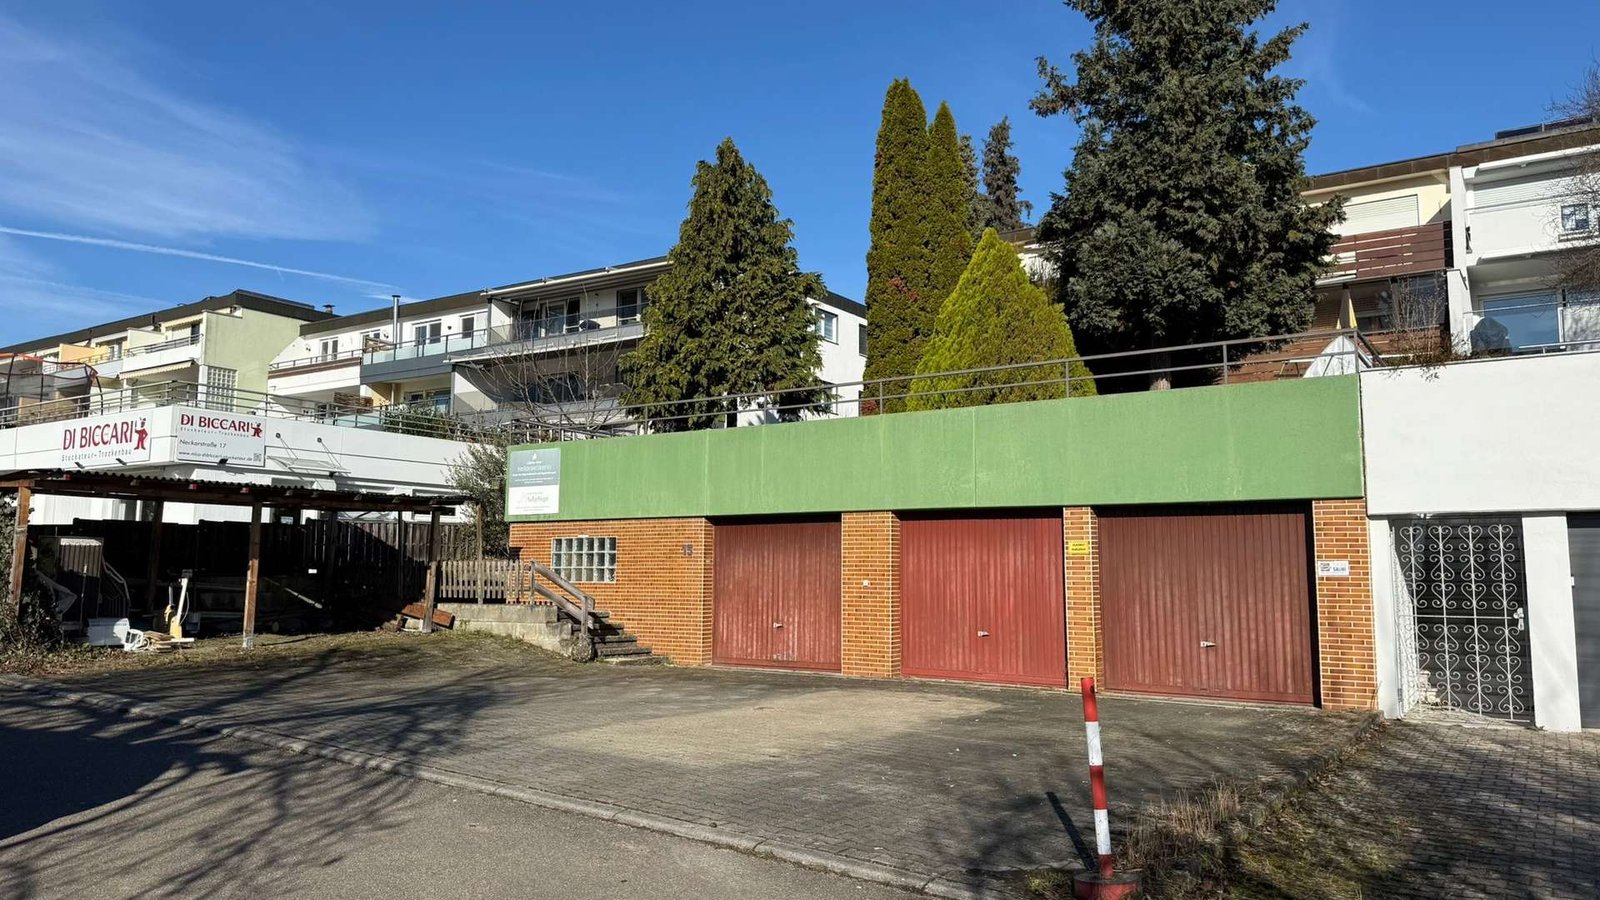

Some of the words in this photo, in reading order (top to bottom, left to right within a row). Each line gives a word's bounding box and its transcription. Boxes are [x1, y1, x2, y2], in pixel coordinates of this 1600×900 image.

[180, 414, 194, 426] DI
[198, 416, 250, 432] BICCARI
[63, 428, 76, 450] DI
[80, 421, 133, 448] BICCARI
[180, 440, 217, 448] Neckarstraße
